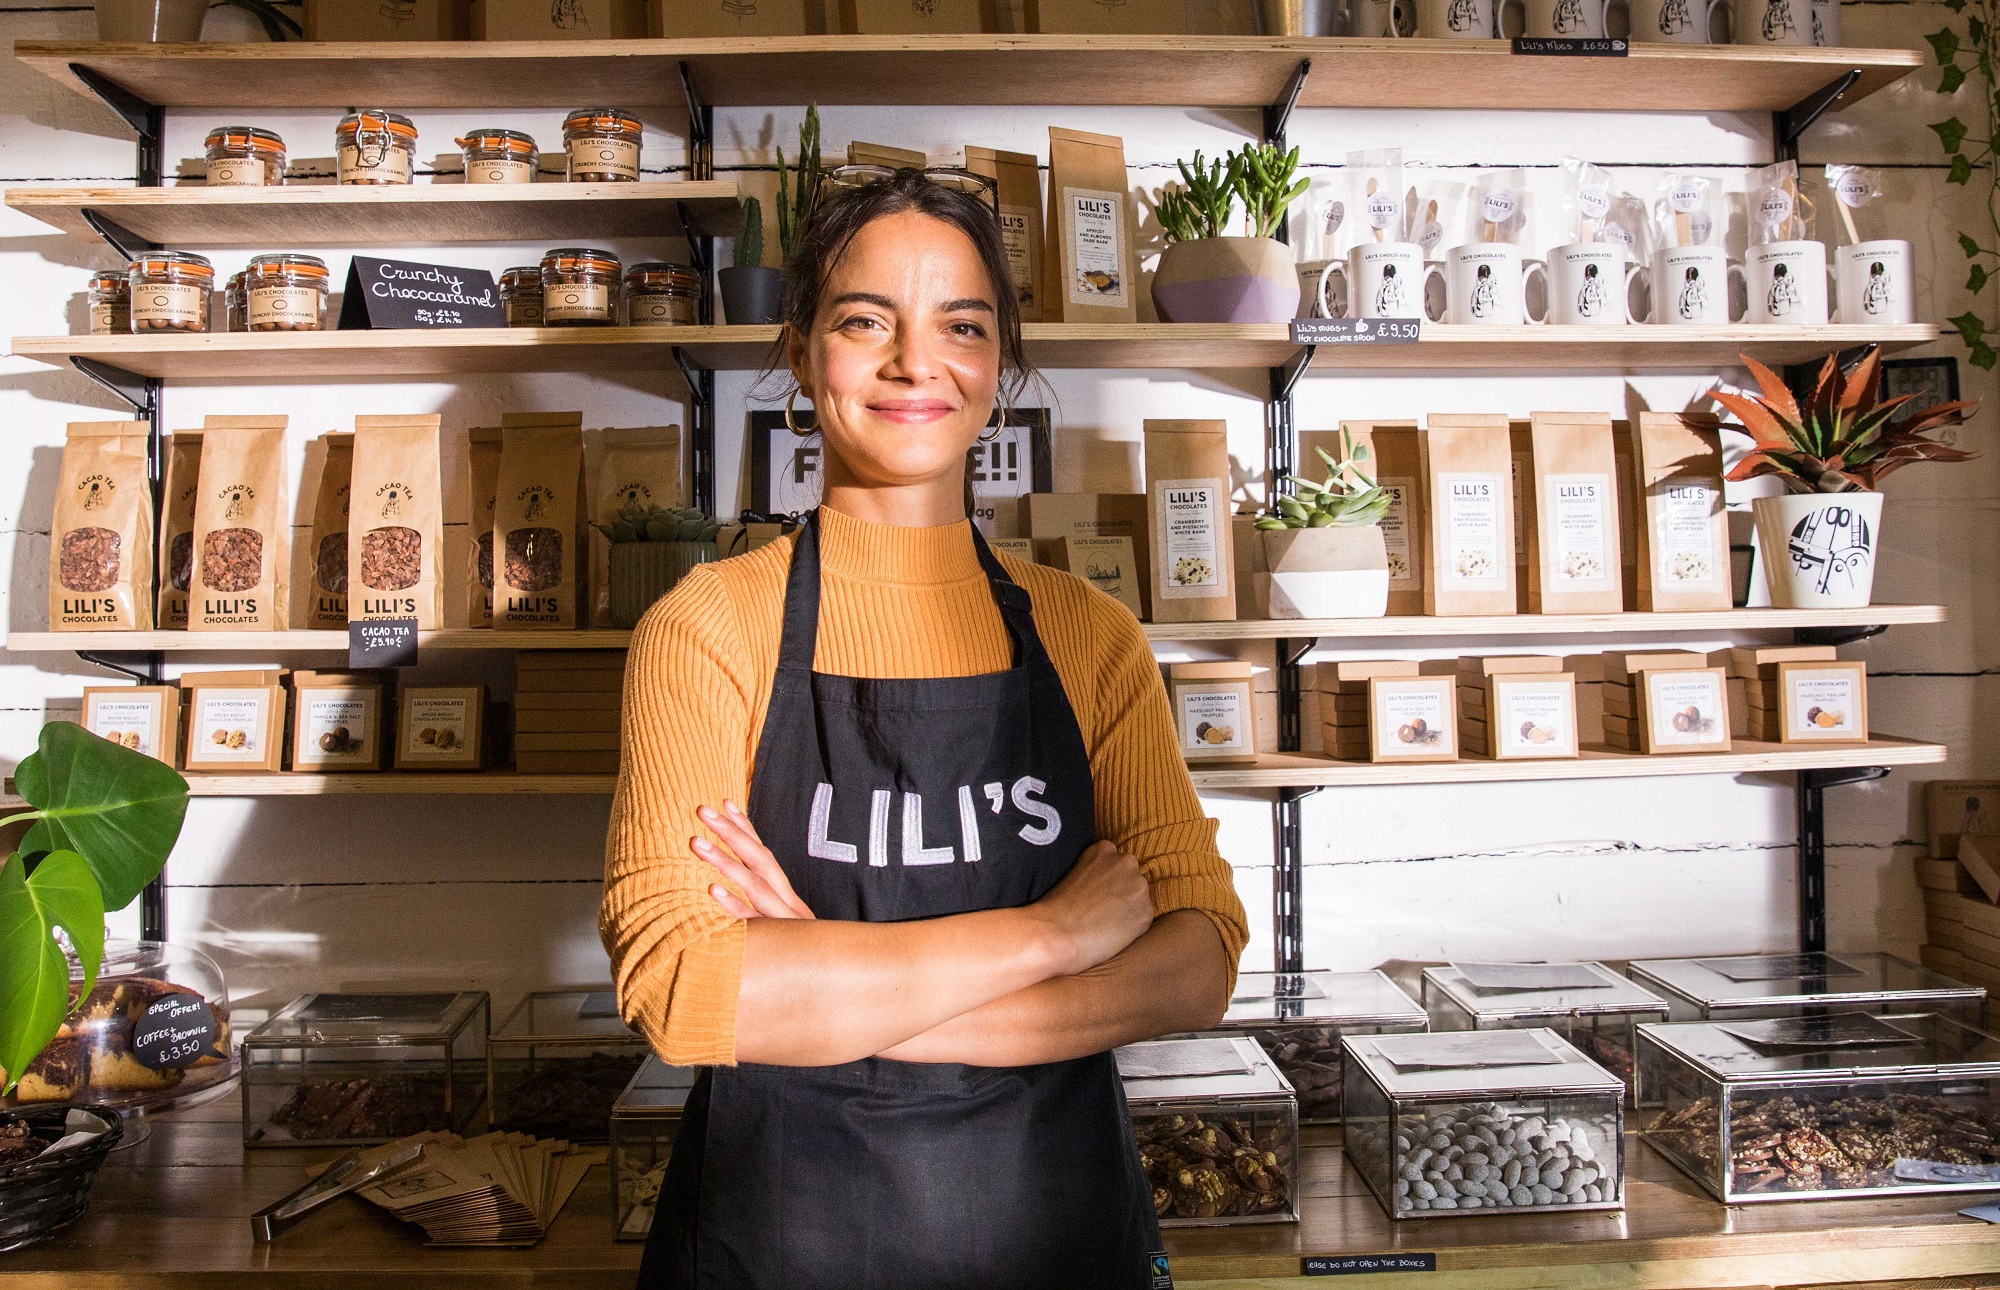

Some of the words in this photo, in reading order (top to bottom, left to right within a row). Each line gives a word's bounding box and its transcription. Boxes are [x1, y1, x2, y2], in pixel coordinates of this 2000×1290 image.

[597, 140, 633, 149] CHOCOLATES
[598, 161, 636, 172] CHOCOCARAMEL
[1078, 200, 1110, 214] LILI'S
[1489, 199, 1508, 208] LILI'S
[1584, 194, 1602, 205] LILI'S
[1078, 212, 1111, 220] CHOCOLATES
[380, 264, 464, 295] Crunchy
[372, 282, 496, 308] Chococaramel
[1377, 323, 1418, 338] £9.50
[78, 474, 103, 490] CACAO
[105, 476, 115, 490] TEA
[219, 485, 244, 499] CACAO
[245, 487, 254, 500] TEA
[376, 483, 401, 497] CACAO
[402, 486, 413, 500] TEA
[518, 486, 542, 501] CACAO
[544, 488, 555, 501] TEA
[617, 483, 640, 498] CACAO
[1170, 492, 1207, 503] LILI'S
[1454, 485, 1489, 495] LILI'S
[1560, 486, 1595, 497] LILI'S
[1670, 488, 1704, 499] LILI'S
[64, 599, 115, 614] LILI'S
[205, 599, 257, 614] LILI'S
[364, 598, 416, 614] LILI'S
[508, 597, 558, 612] LILI'S
[362, 627, 390, 636] CACAO
[393, 627, 410, 636] TEA
[370, 637, 395, 648] £5.90
[808, 775, 1062, 867] LILI'S
[137, 1029, 170, 1048] COFFEE
[171, 1026, 207, 1043] BROWNIE
[160, 1040, 199, 1062] £3.50
